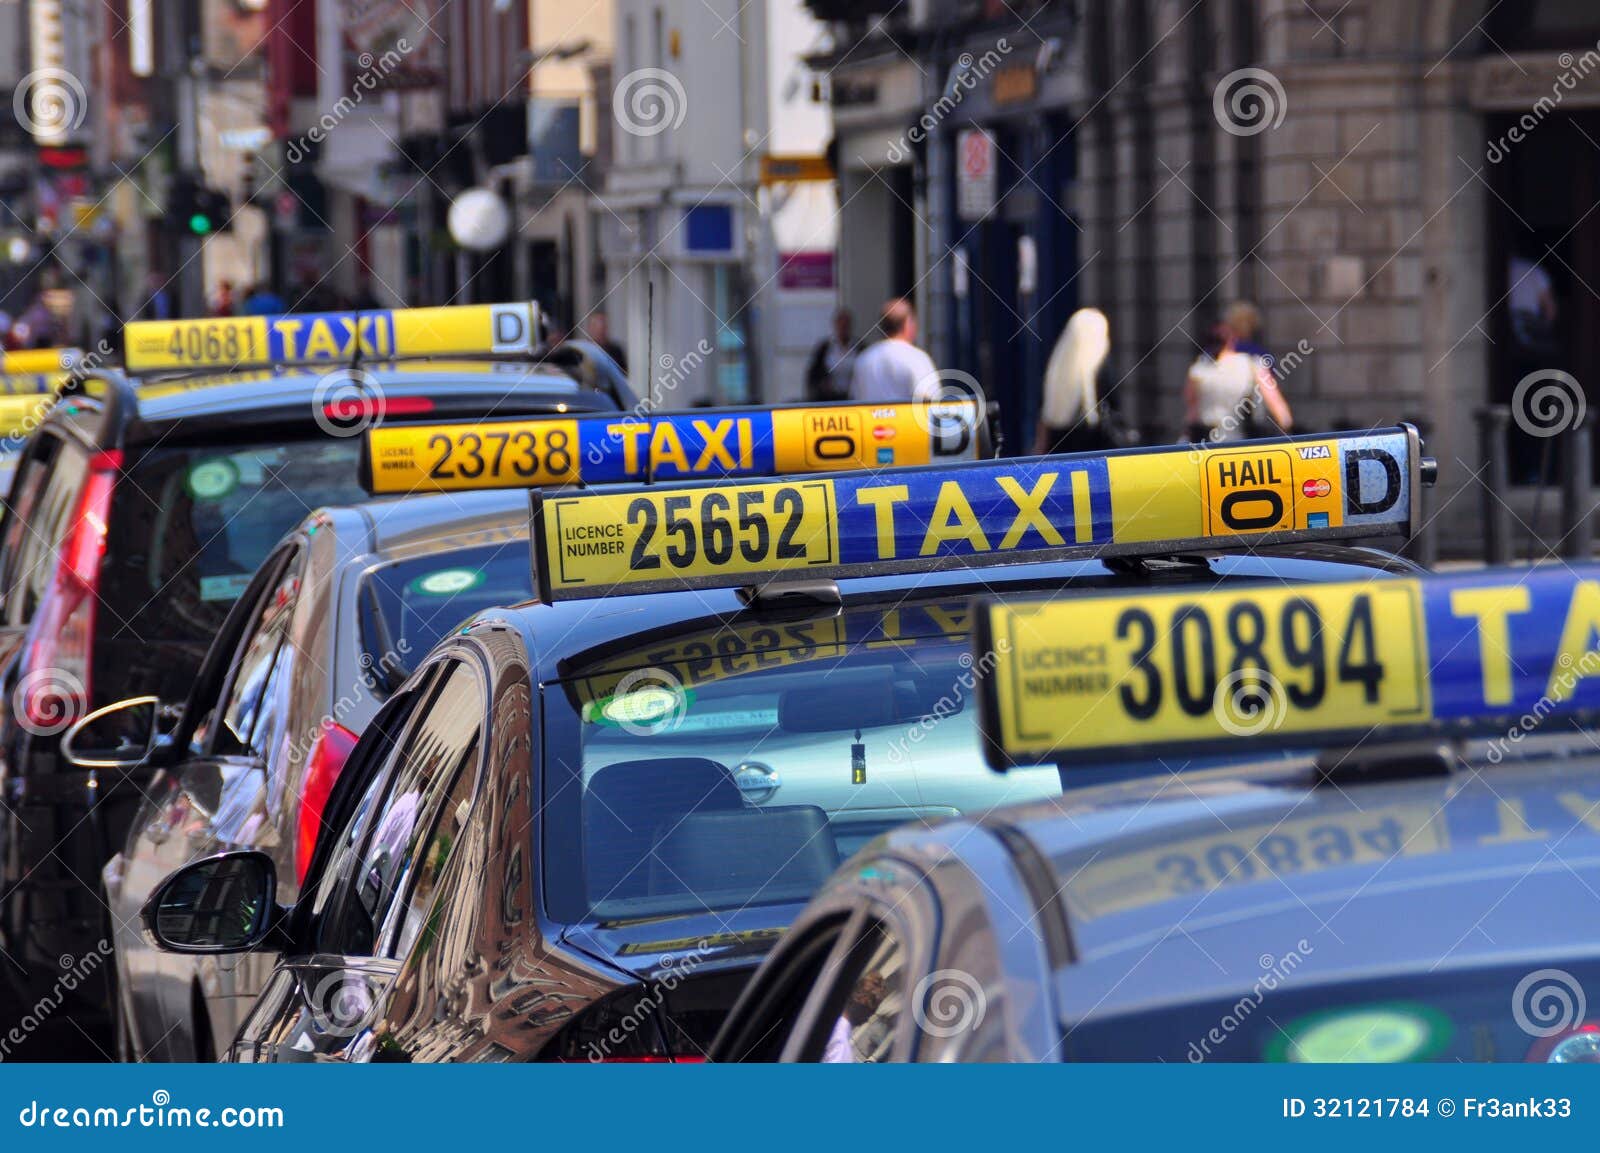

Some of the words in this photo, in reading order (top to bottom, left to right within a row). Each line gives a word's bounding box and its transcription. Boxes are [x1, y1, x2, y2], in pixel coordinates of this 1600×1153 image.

[168, 324, 255, 362] 40681
[273, 315, 390, 361] TAXI
[496, 312, 523, 344] D
[812, 416, 854, 432] HAIL
[932, 411, 971, 457] D
[428, 429, 572, 479] 23738
[606, 418, 754, 475] TAXI
[1298, 446, 1330, 460] VISA
[1219, 458, 1281, 488] HAIL
[1345, 448, 1401, 516] D
[565, 524, 623, 540] LICENCE
[627, 487, 807, 571] 25652
[856, 470, 1093, 560] TAXI
[567, 541, 625, 557] NUMBER
[1021, 645, 1108, 672] LICENCE
[1115, 593, 1385, 721] 30894
[1025, 673, 1111, 698] NUMBER
